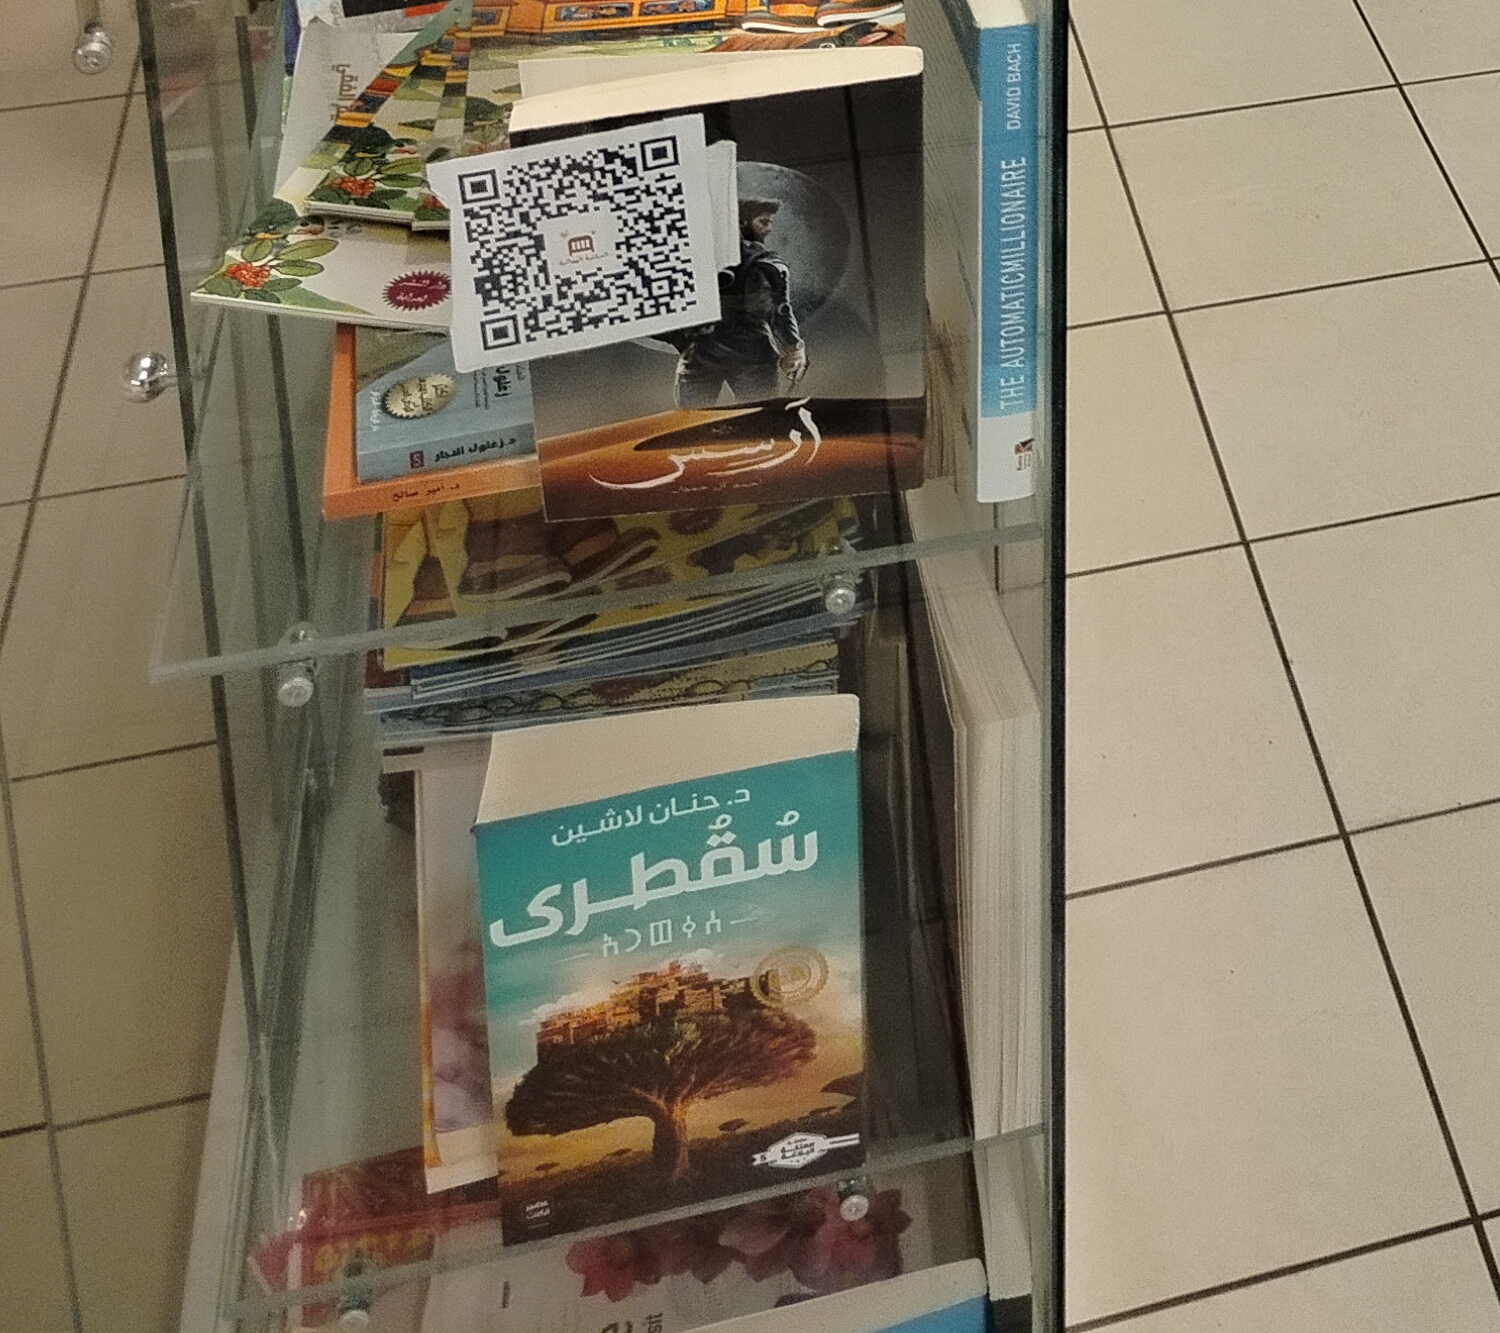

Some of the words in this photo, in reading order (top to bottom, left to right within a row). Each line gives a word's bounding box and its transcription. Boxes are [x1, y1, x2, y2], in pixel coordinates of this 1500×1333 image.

[1006, 42, 1022, 85] BACH
[1007, 92, 1022, 131] DAVID
[1001, 155, 1026, 370] AUTOMATICMILLIONAIRE
[1001, 374, 1025, 410] THE
[649, 792, 720, 825] حنان
[727, 788, 750, 806] د.
[551, 804, 643, 847] لاشين
